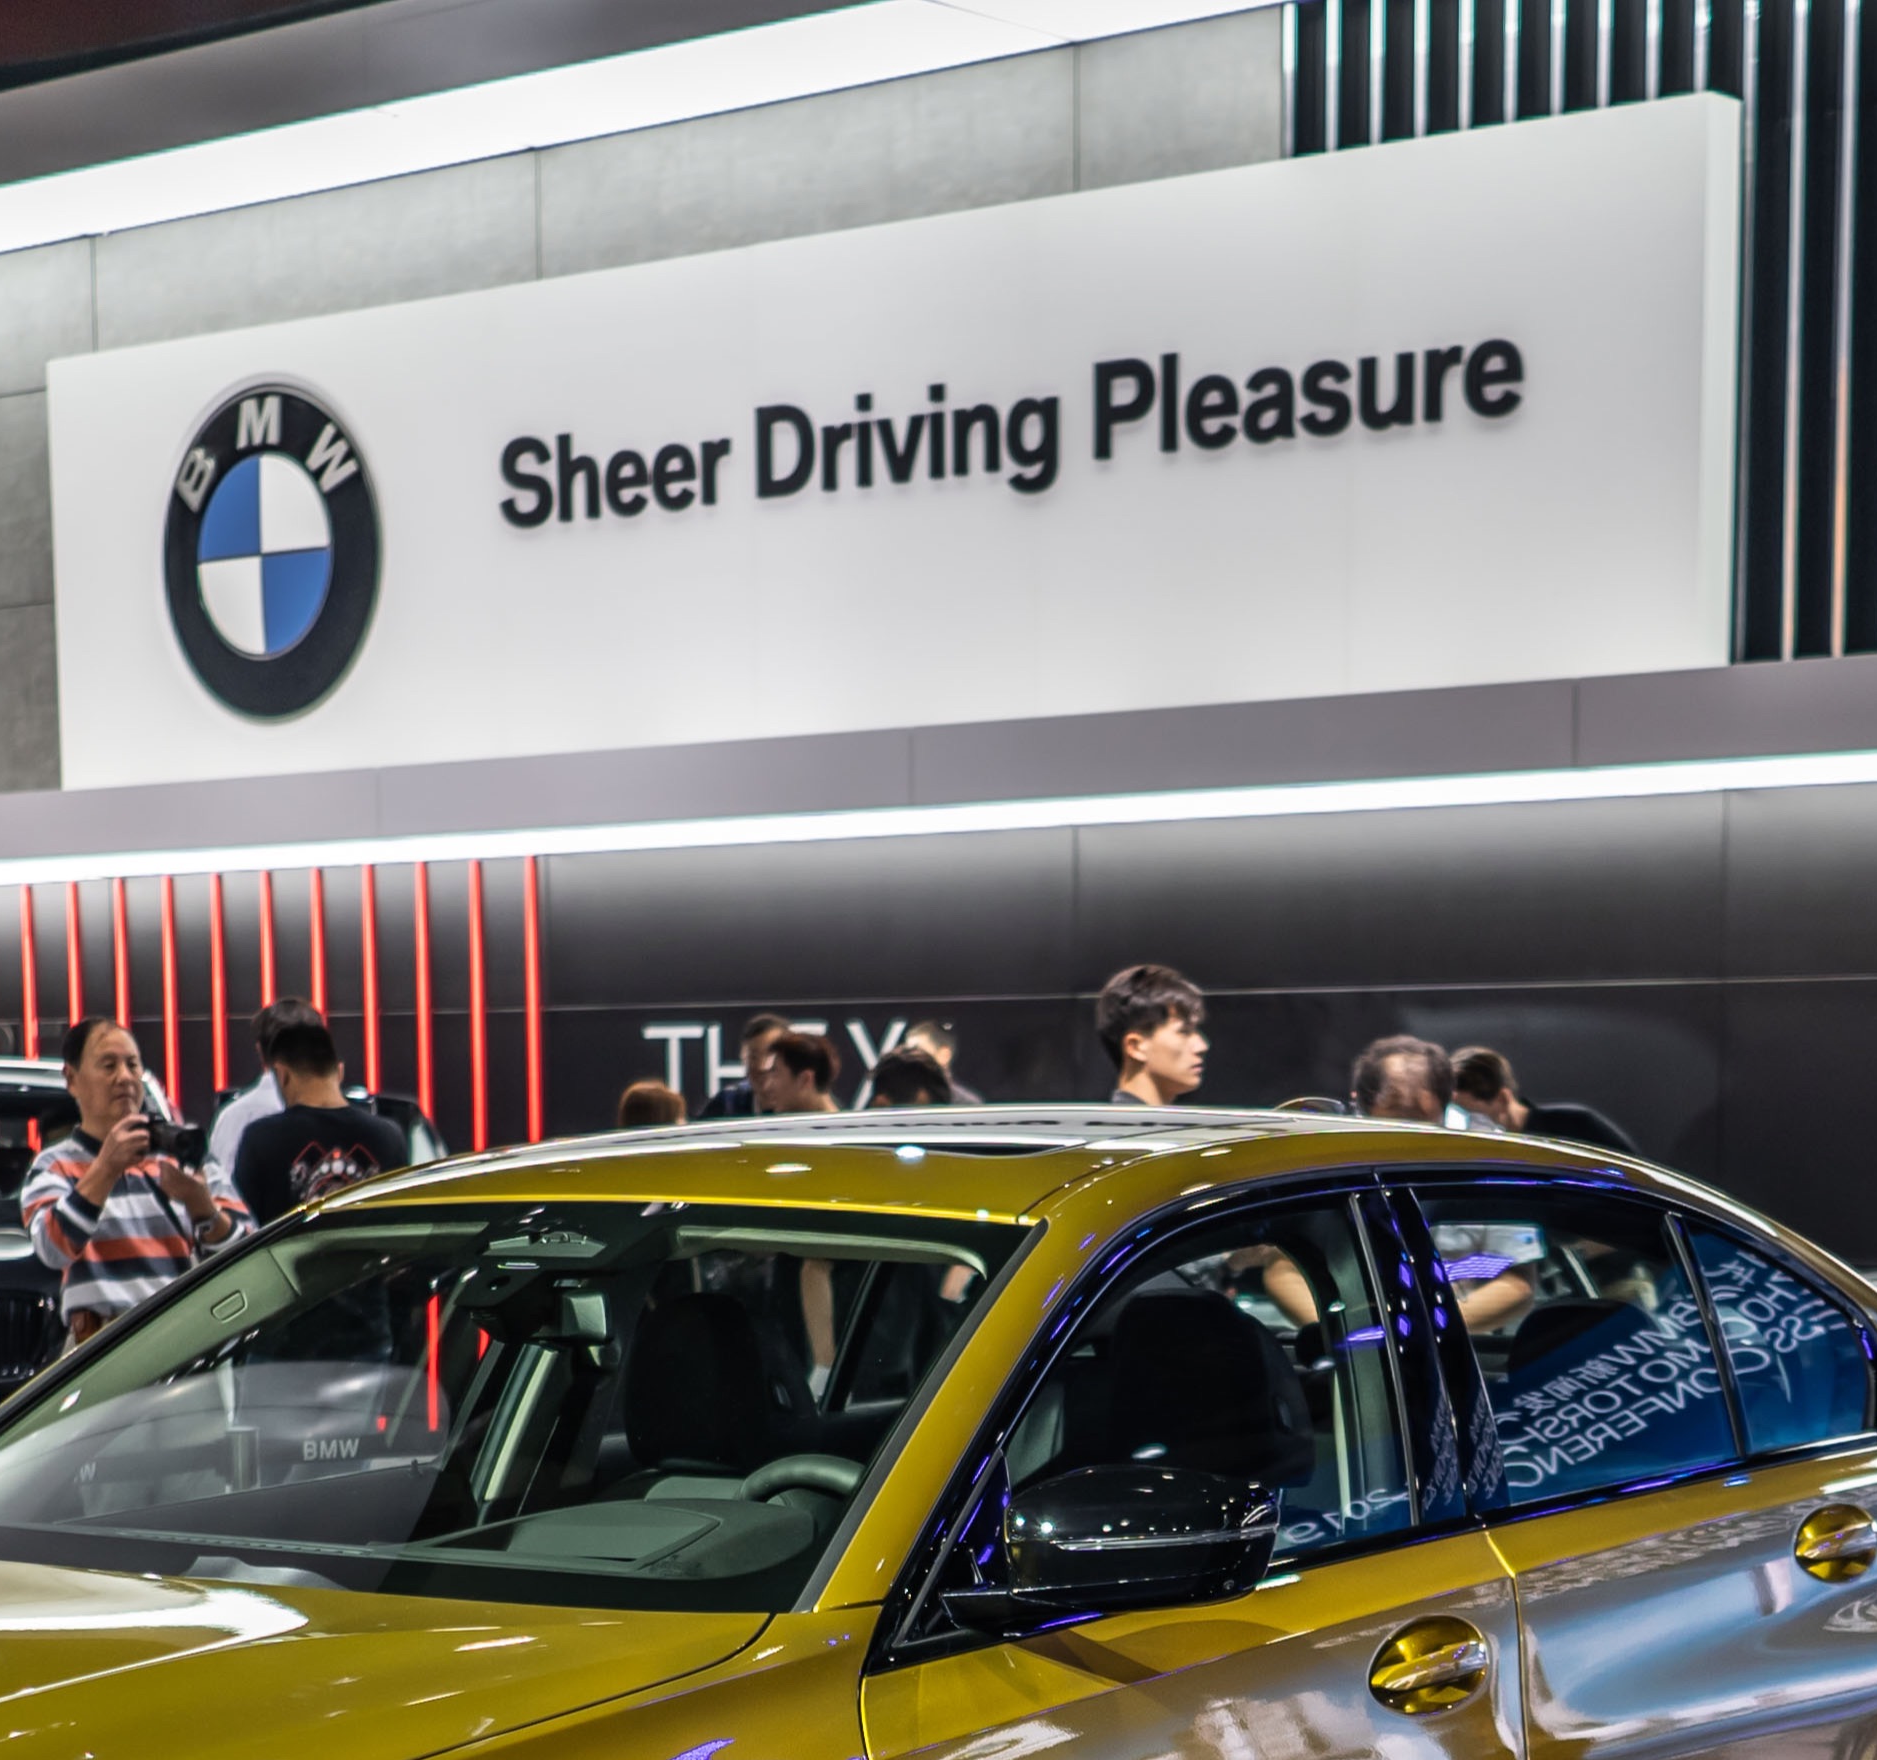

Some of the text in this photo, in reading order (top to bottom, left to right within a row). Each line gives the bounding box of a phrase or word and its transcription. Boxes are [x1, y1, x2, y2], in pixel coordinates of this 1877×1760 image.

[174, 391, 360, 513] BMW
[500, 338, 1526, 529] Sheer Driving Pleasure
[303, 1438, 359, 1461] BMW
